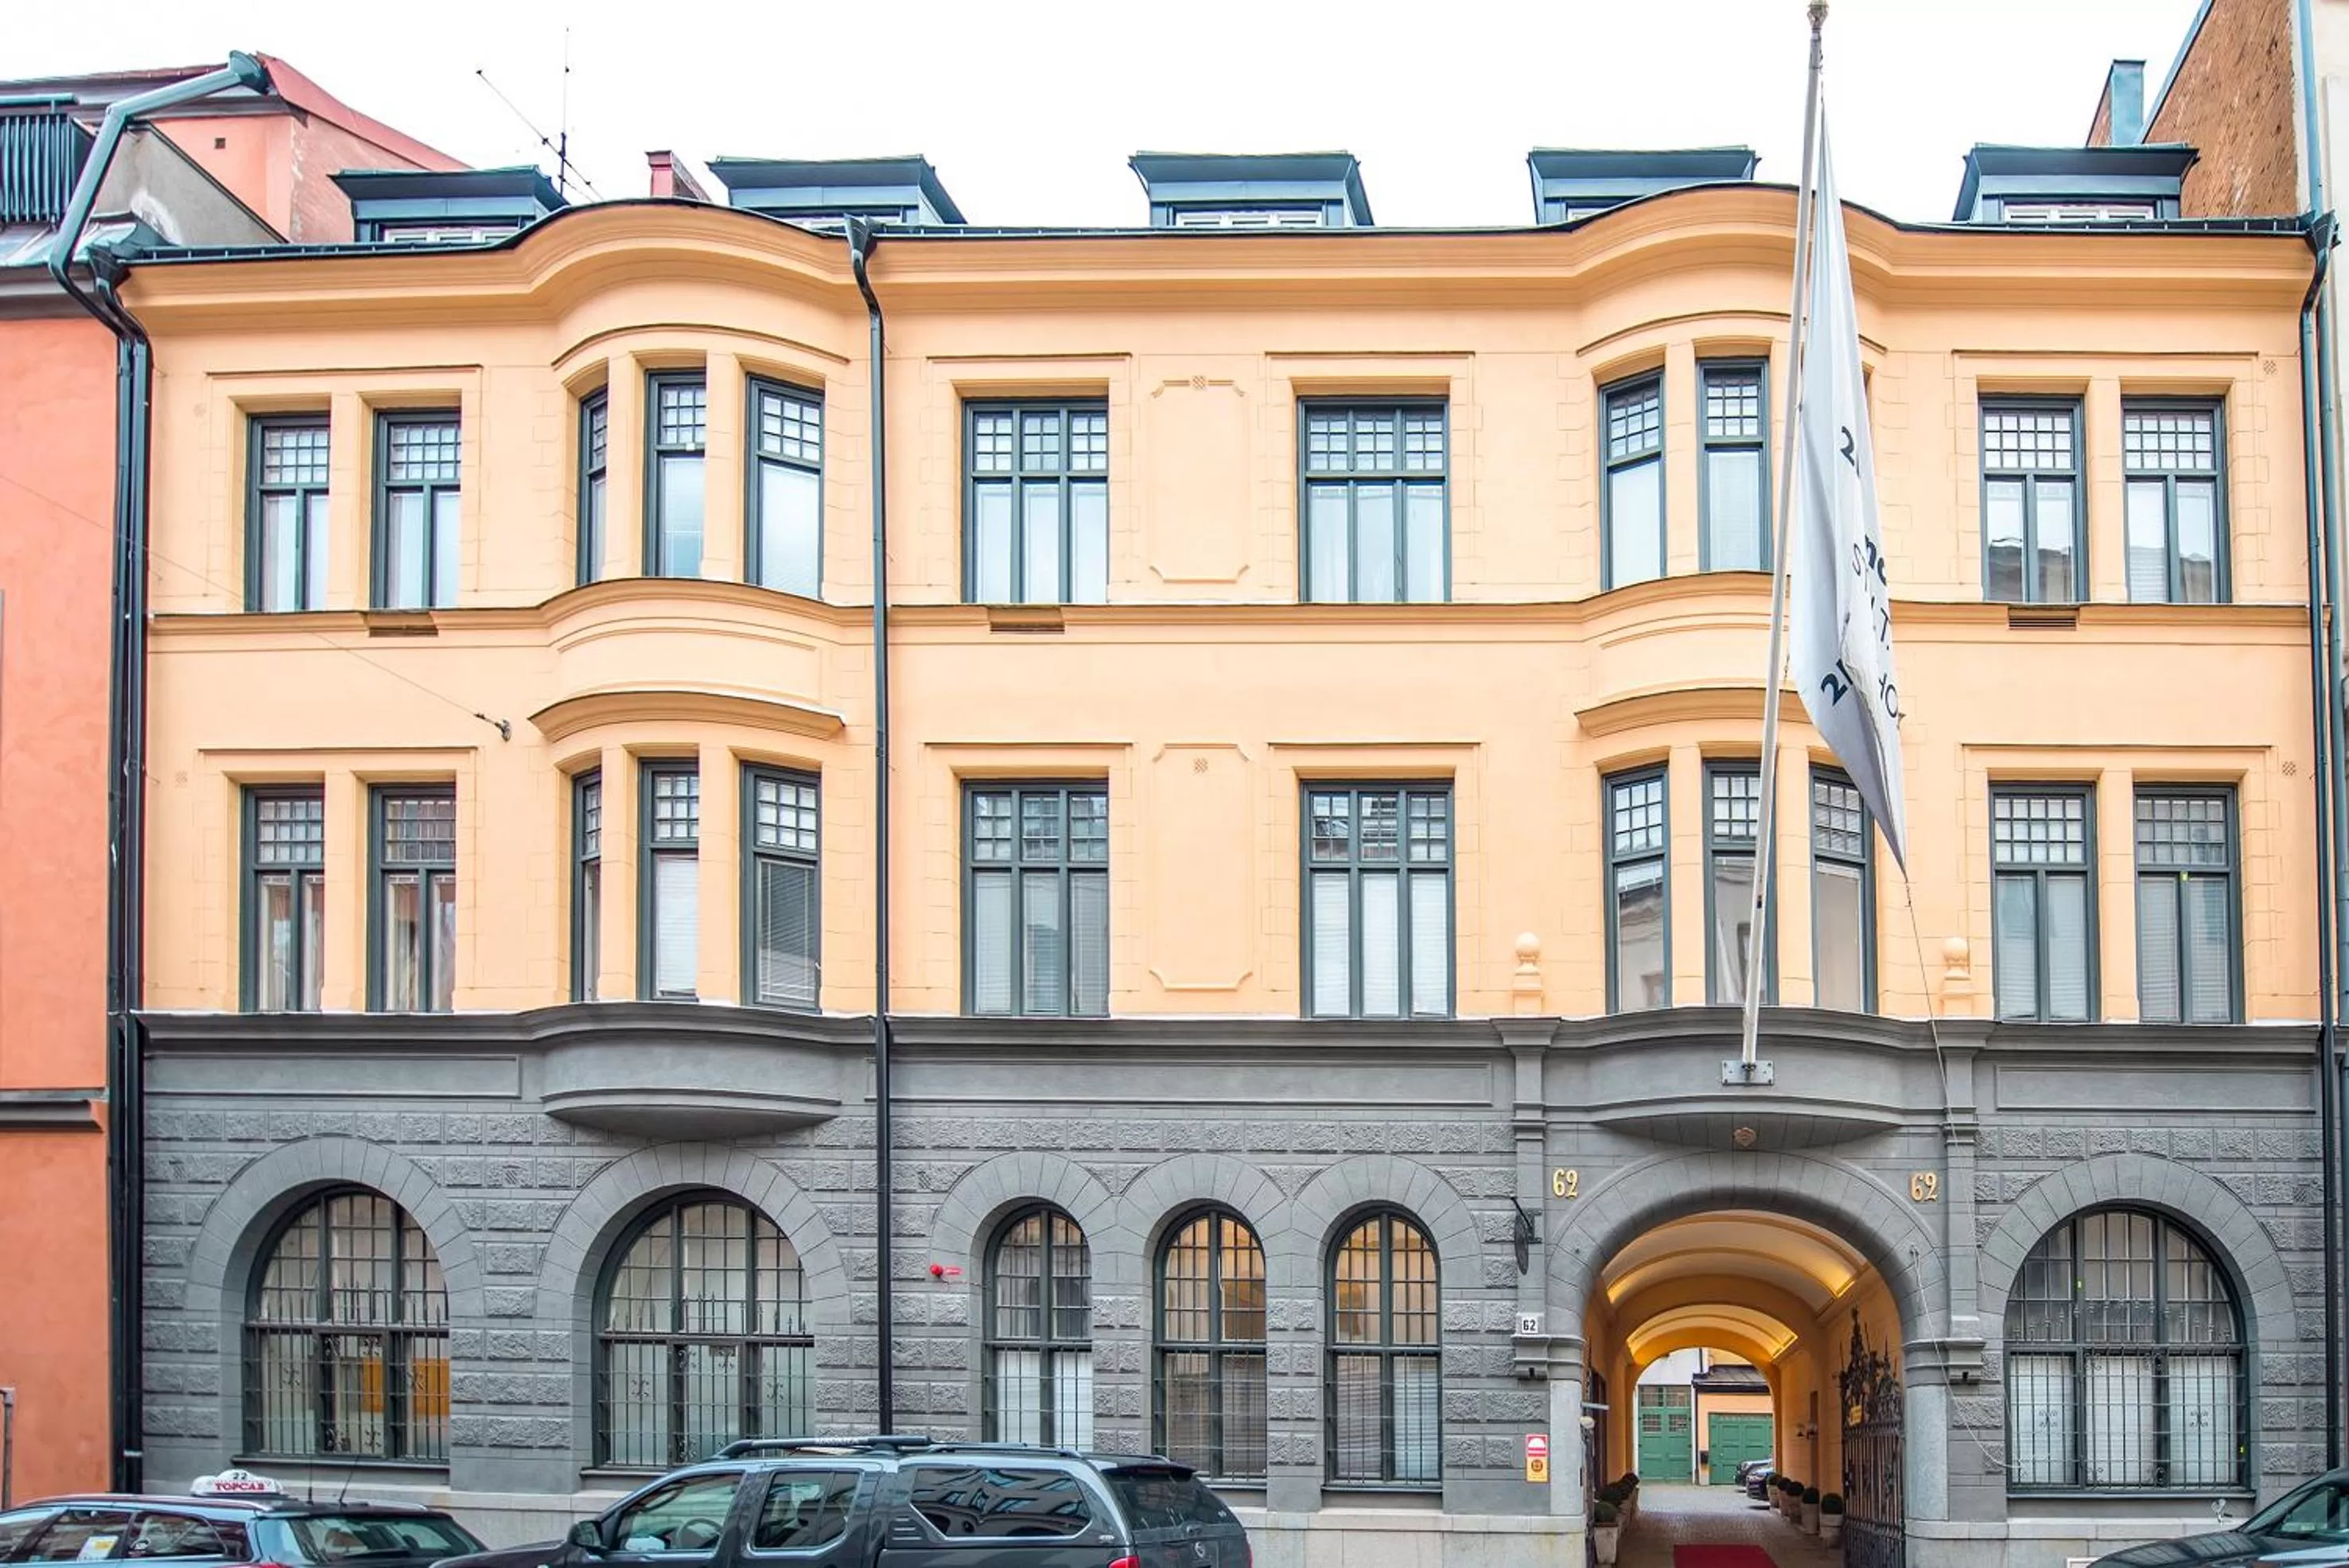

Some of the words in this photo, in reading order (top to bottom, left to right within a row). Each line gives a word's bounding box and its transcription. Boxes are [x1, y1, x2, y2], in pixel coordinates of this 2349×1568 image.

[1553, 1169, 1579, 1198] 62
[1911, 1173, 1938, 1202] 62
[1523, 1319, 1536, 1331] 62
